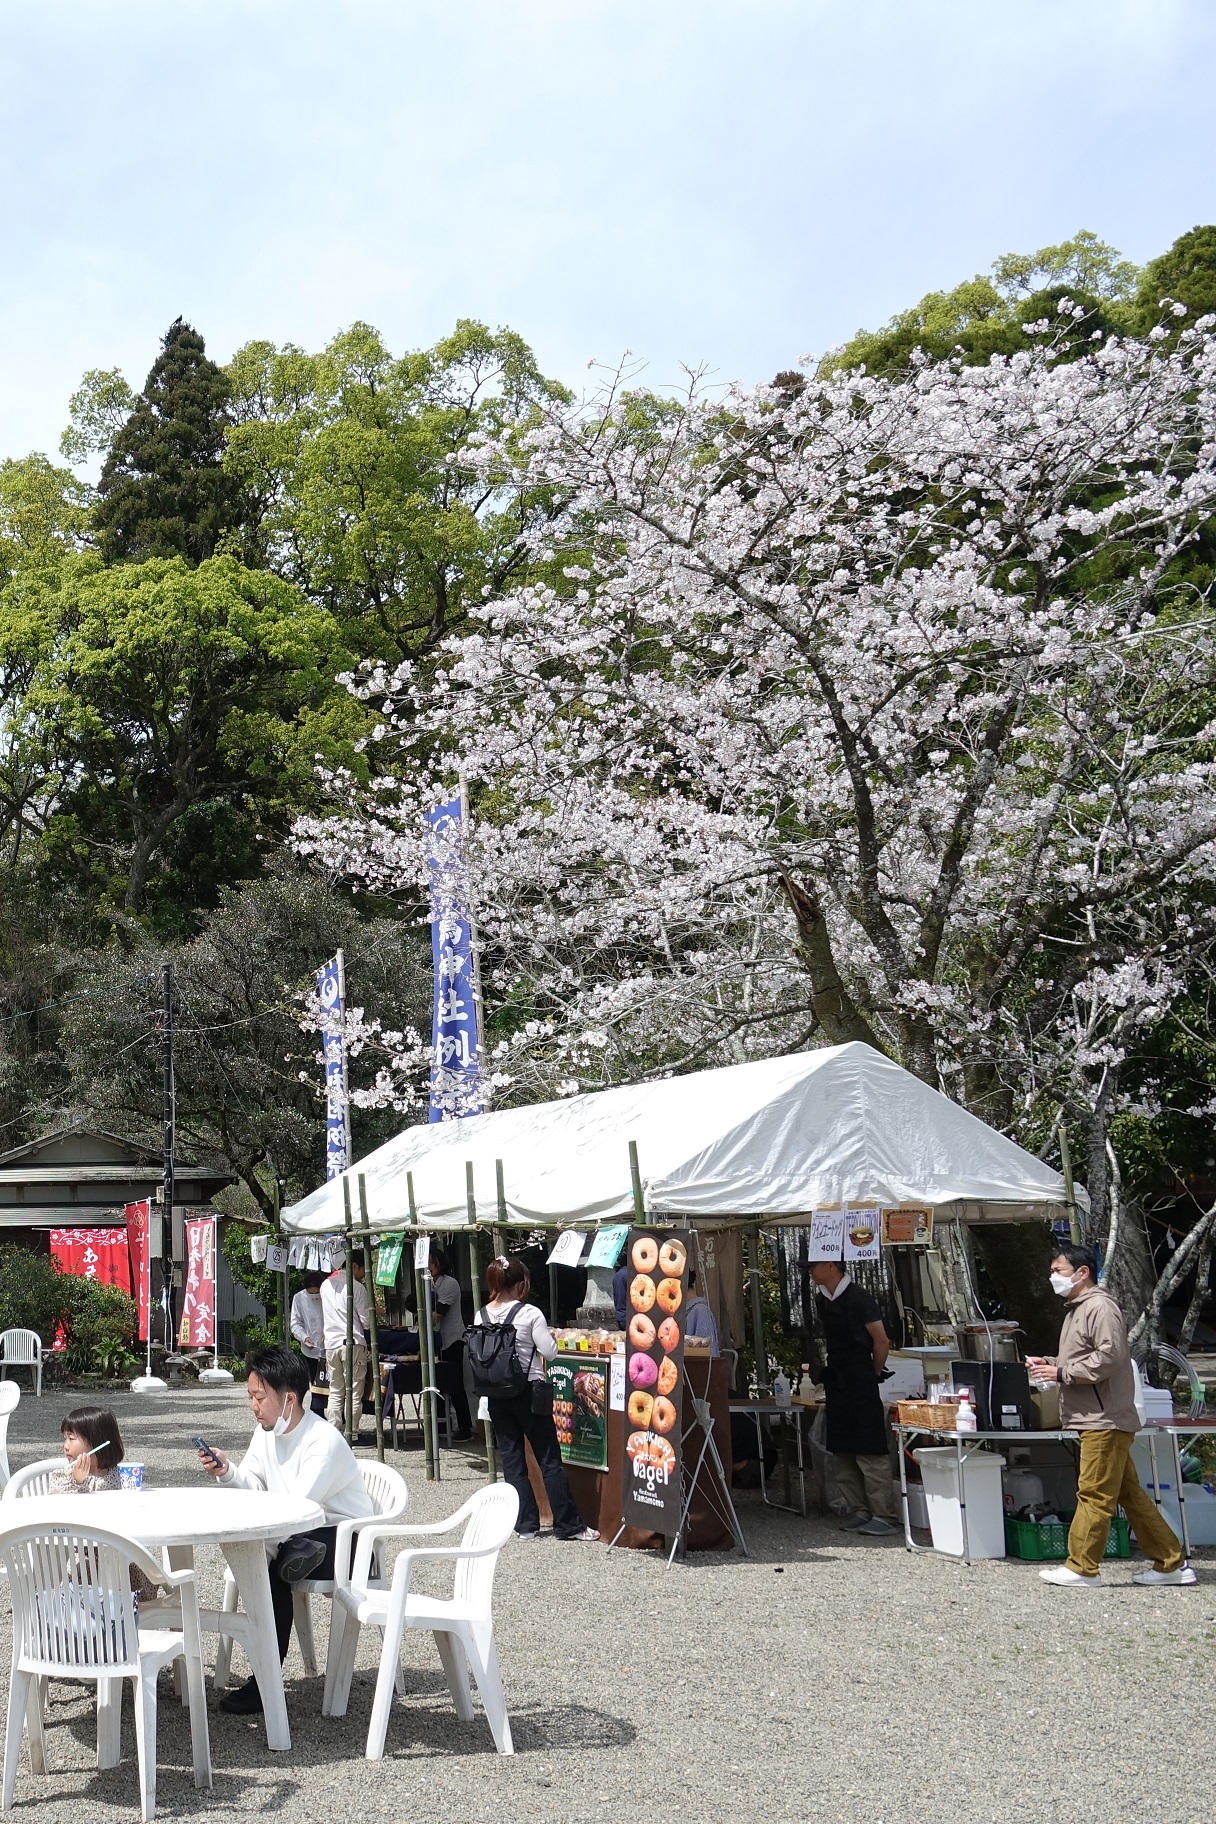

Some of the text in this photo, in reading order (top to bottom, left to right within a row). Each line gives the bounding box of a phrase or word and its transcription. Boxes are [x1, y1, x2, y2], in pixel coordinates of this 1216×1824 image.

[547, 1365, 574, 1380] YASUKICHI
[632, 1454, 669, 1491] Bagel
[632, 1490, 665, 1509] Yamamomo
